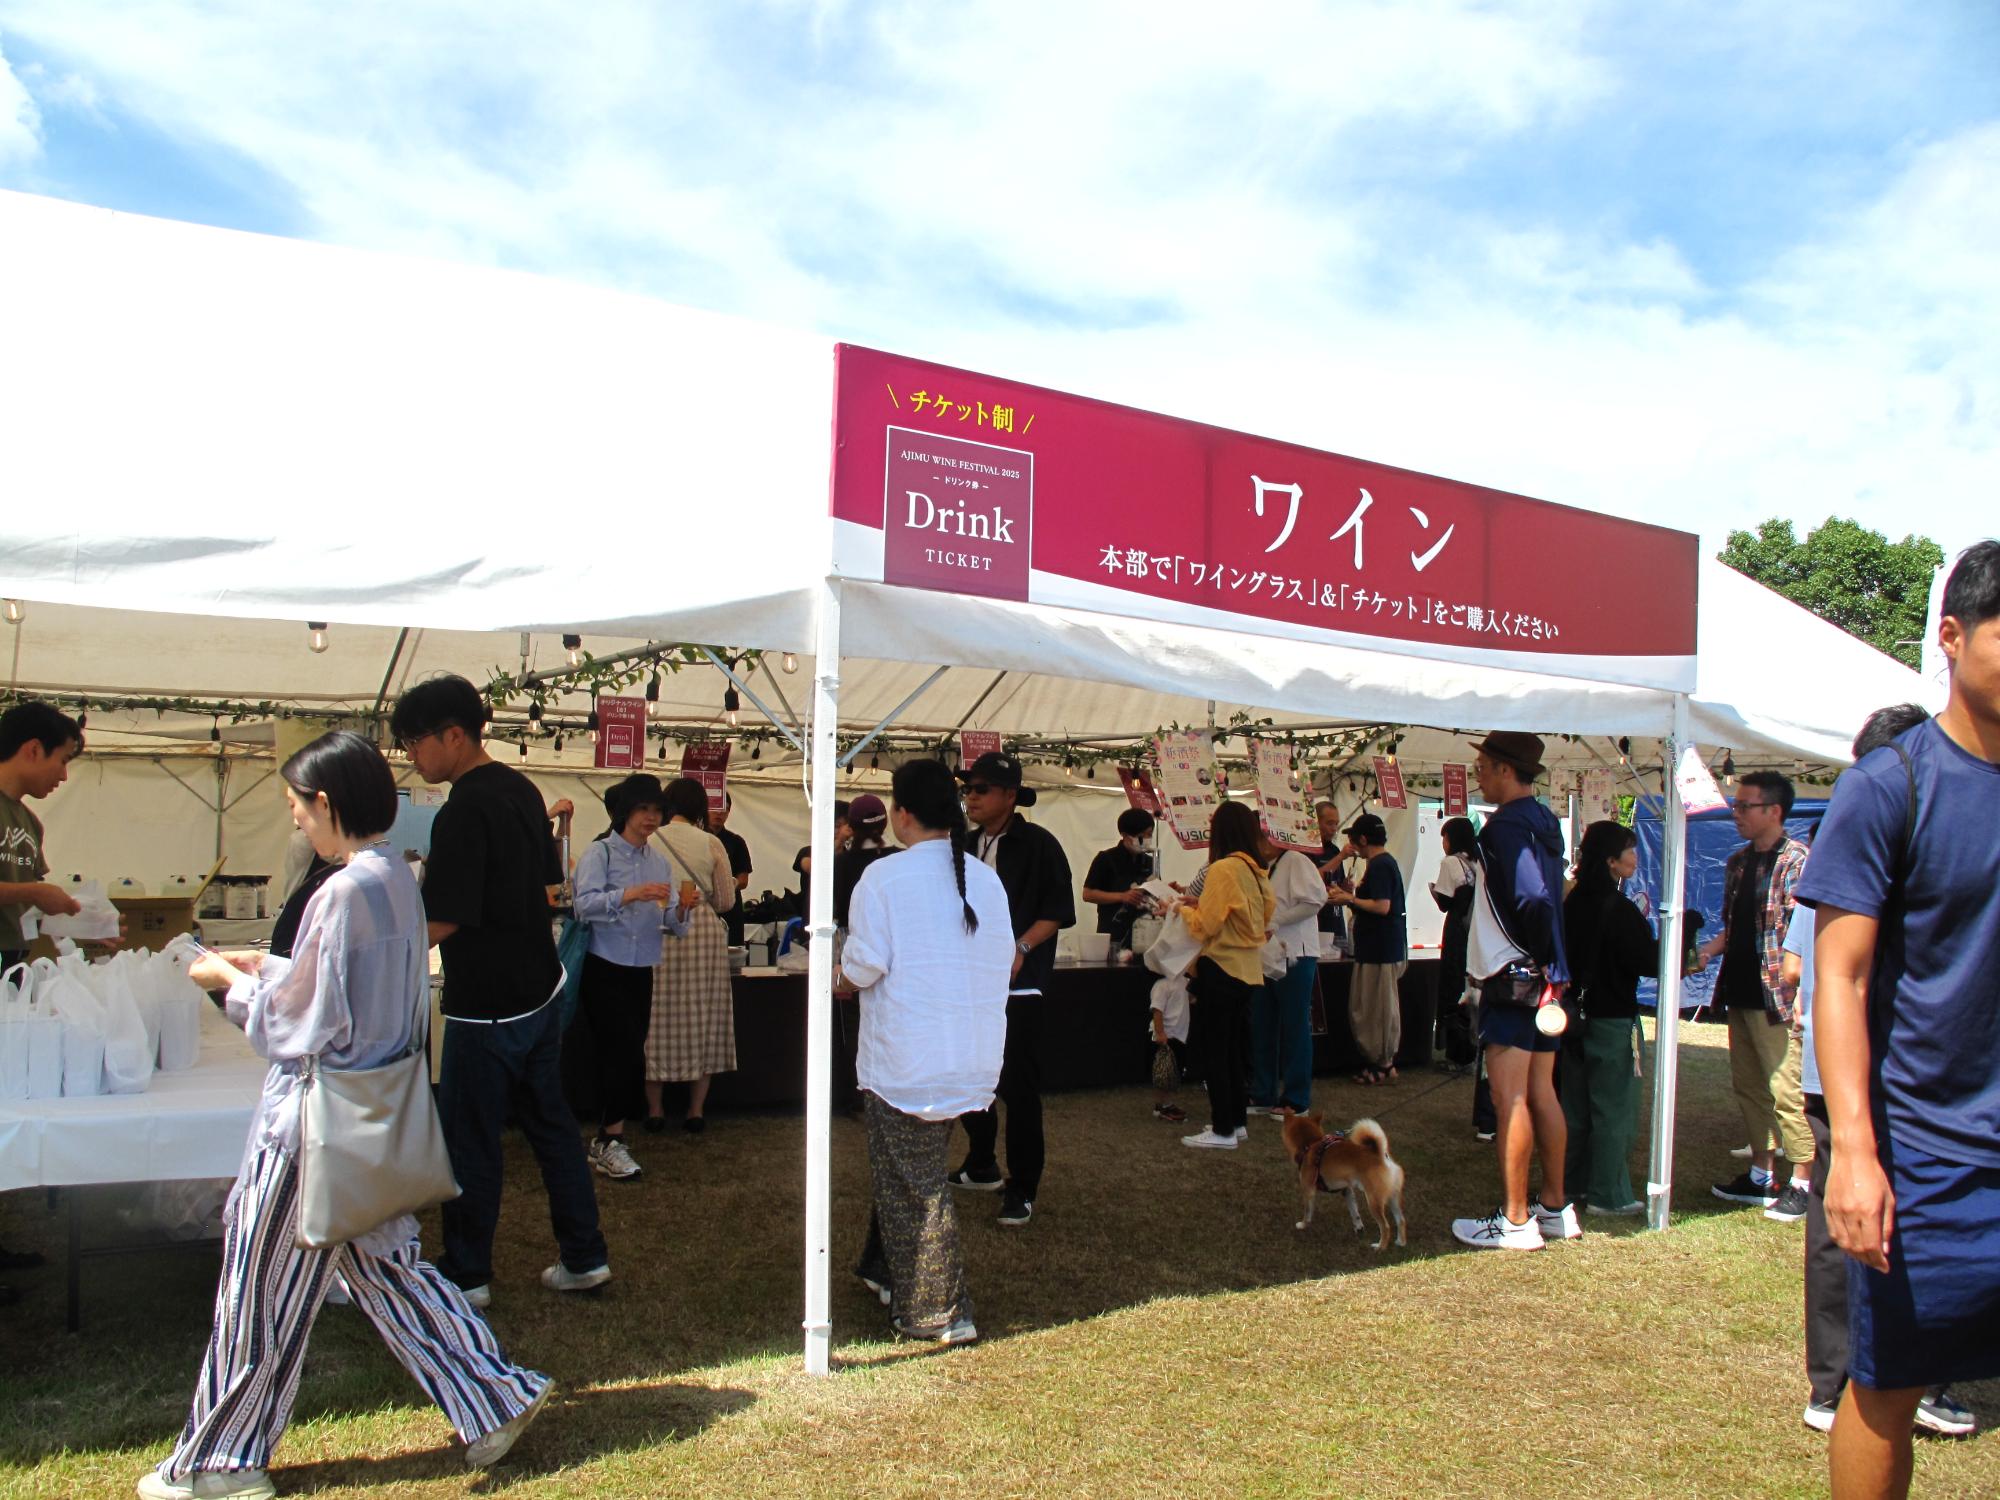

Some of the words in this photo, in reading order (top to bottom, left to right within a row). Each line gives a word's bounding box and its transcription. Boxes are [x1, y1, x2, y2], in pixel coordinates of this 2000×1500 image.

[909, 390, 1014, 433] チケット制
[901, 450, 930, 463] AJIMU
[932, 455, 957, 468] WINE
[959, 460, 999, 475] FESTIVAL
[1002, 468, 1020, 479] 2025
[905, 490, 1014, 544] Drink
[1250, 474, 1455, 572] ワイン
[925, 548, 992, 571] TICKET
